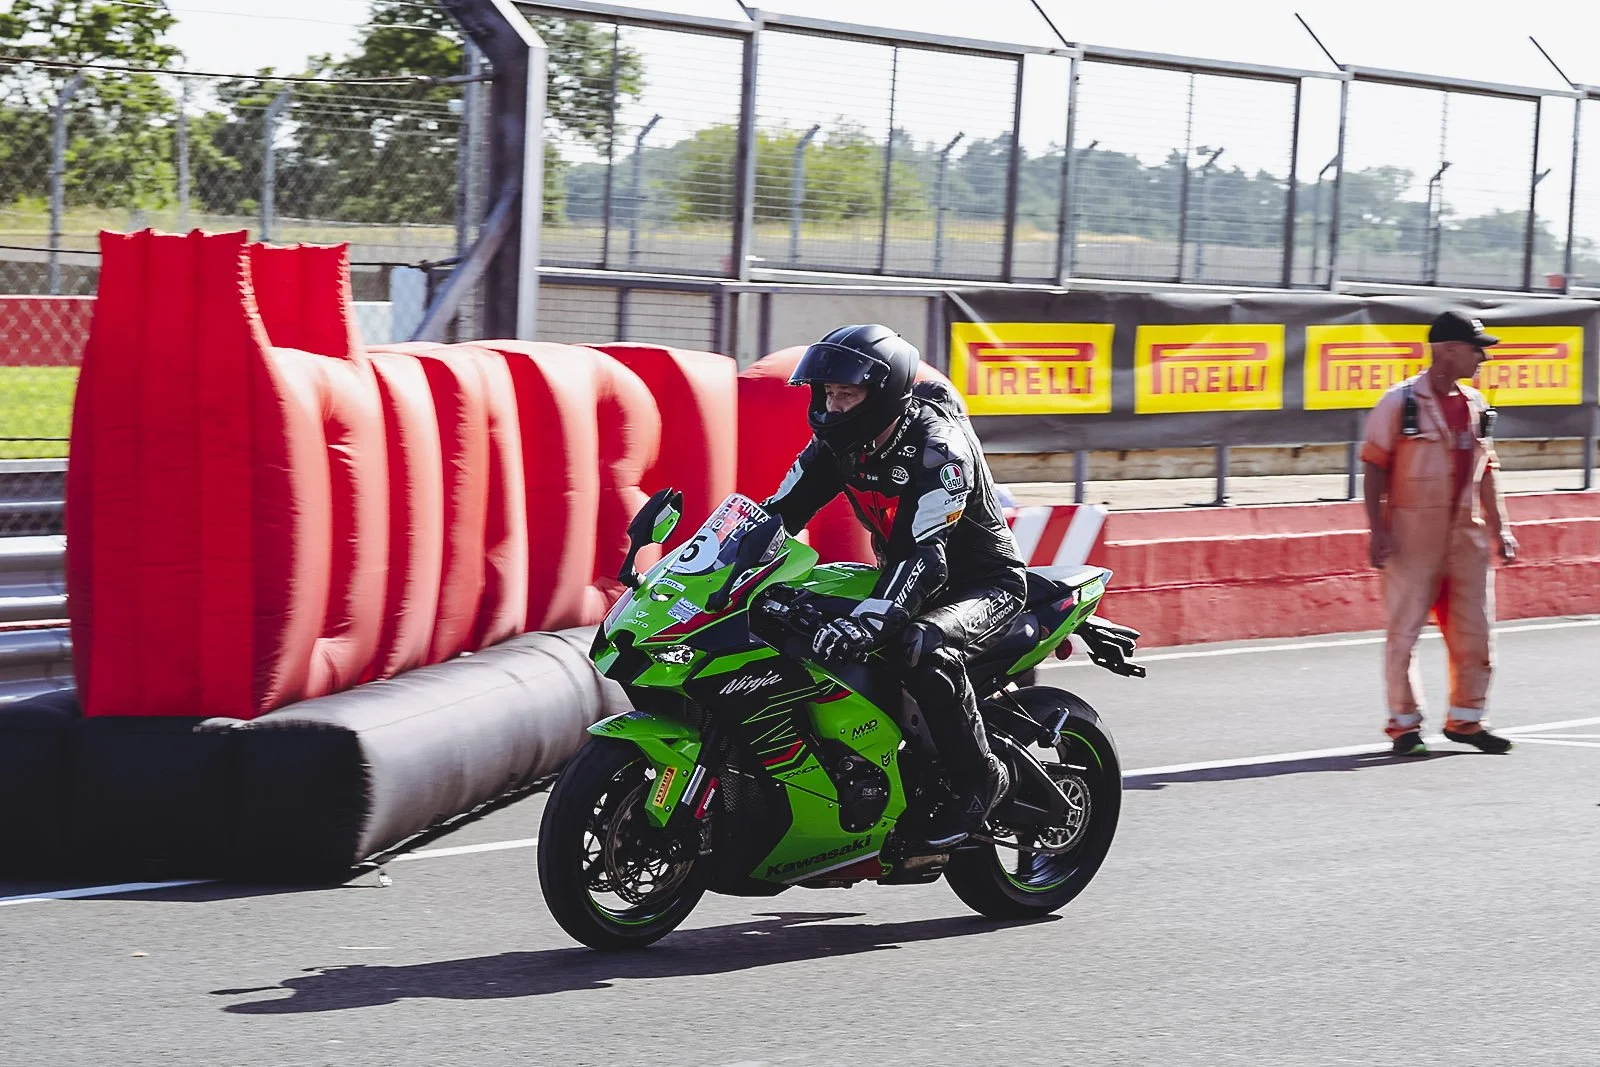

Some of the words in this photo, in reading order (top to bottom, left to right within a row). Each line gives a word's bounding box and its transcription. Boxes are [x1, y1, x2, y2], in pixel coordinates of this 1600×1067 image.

[967, 342, 1097, 396] PIRELLI
[1150, 342, 1268, 395] PIRELLI
[1319, 342, 1424, 392] PIREL
[679, 534, 708, 563] 5
[895, 557, 926, 608] AINESE
[989, 602, 1014, 627] LONDON
[719, 670, 783, 696] Ninja
[852, 719, 878, 737] MAD
[765, 834, 872, 877] Kawasaki
